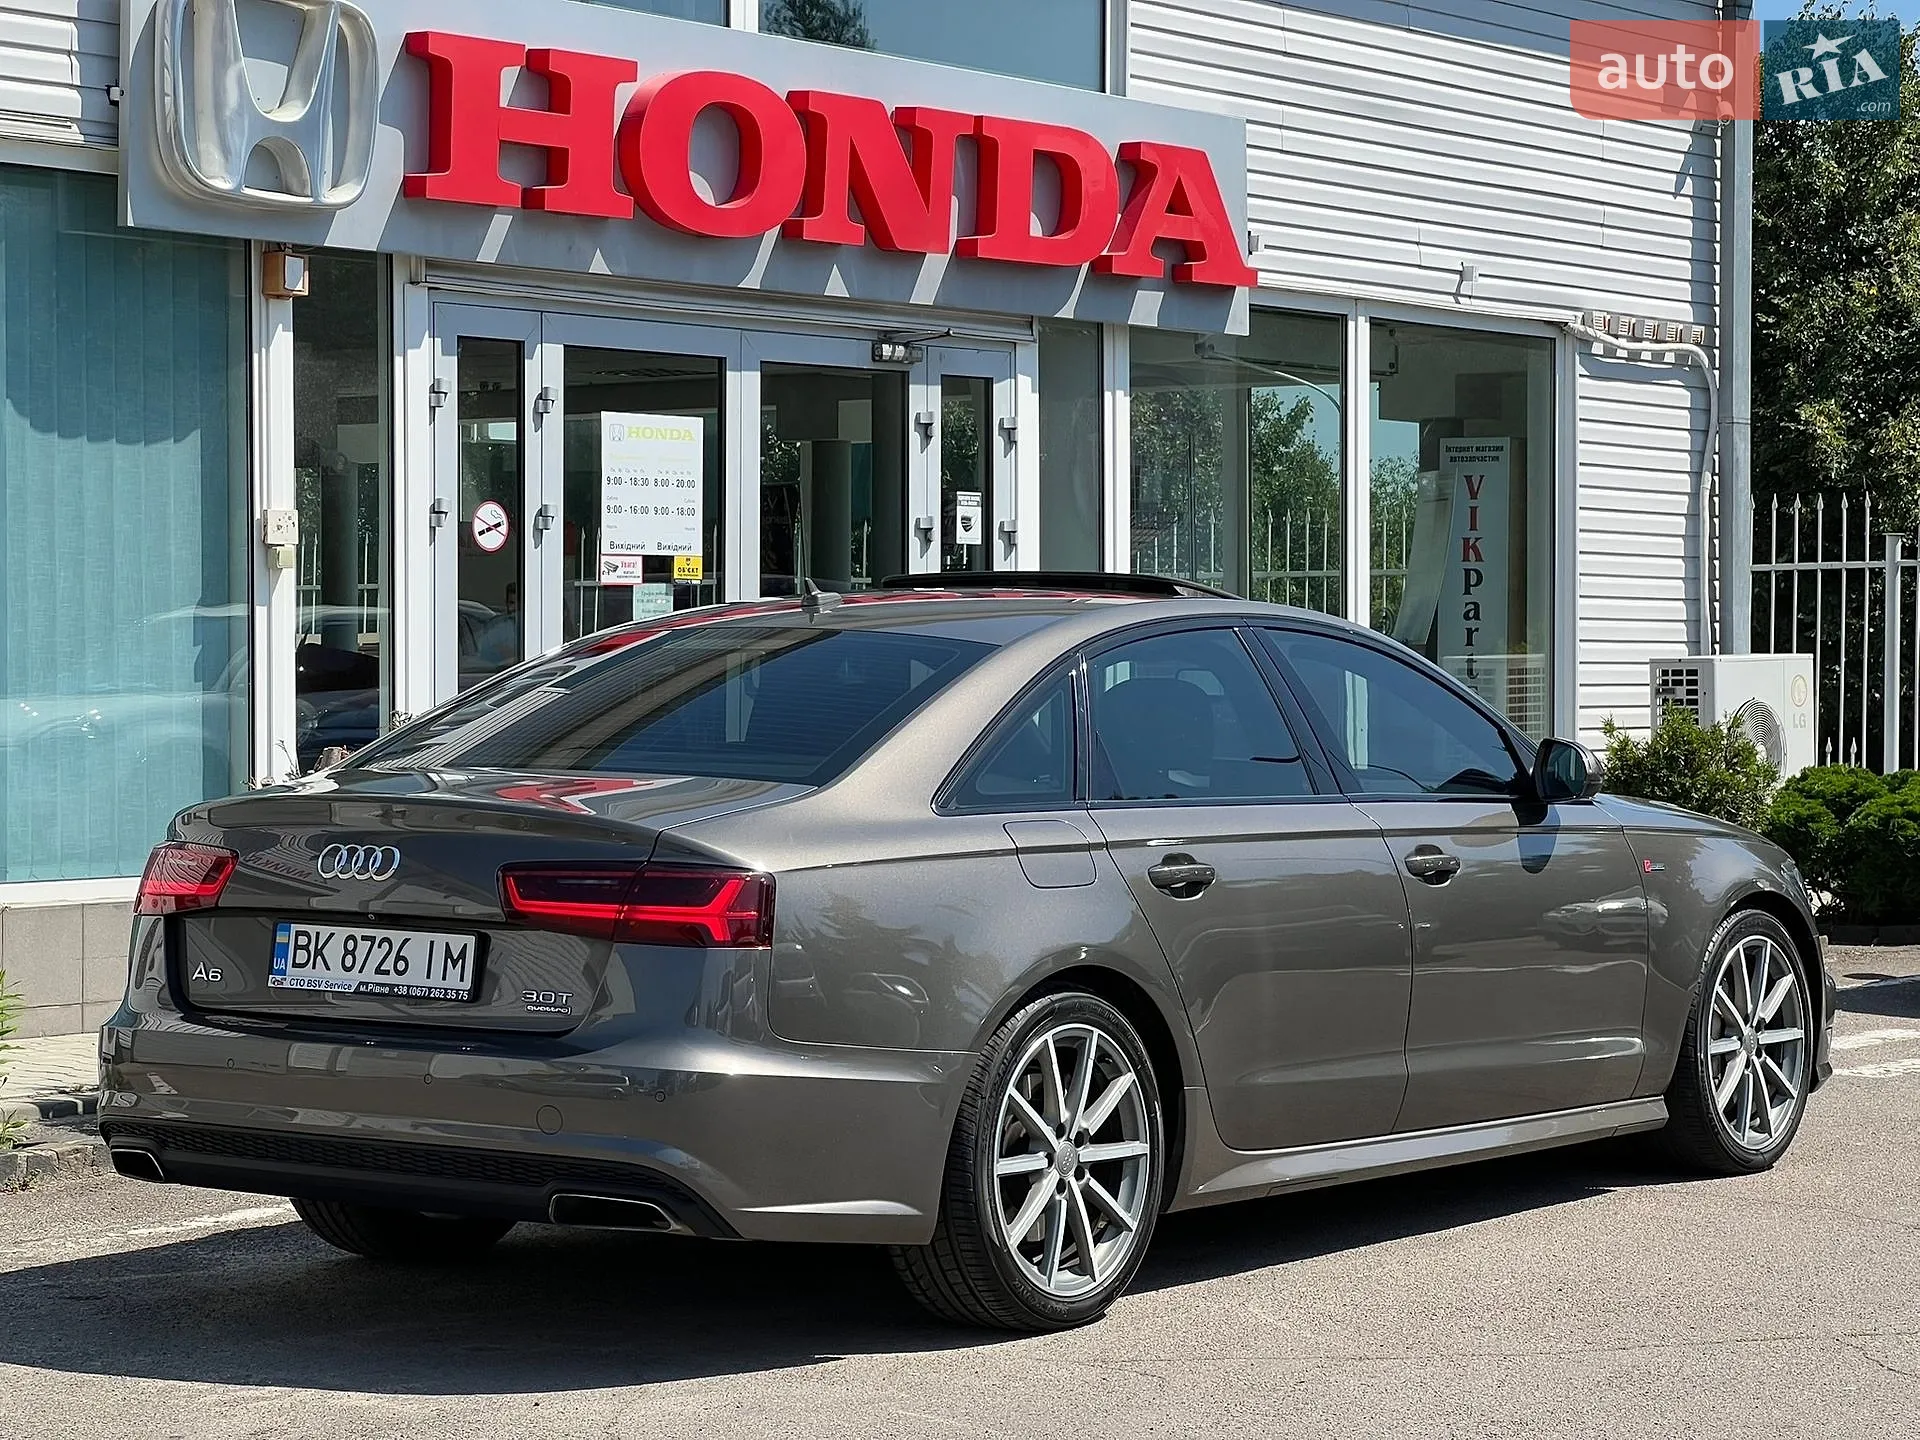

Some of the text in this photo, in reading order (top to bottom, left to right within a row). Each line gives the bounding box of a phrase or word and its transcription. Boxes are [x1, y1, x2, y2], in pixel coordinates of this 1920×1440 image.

[404, 30, 1258, 288] HONDA
[627, 426, 695, 442] HONDA
[1445, 445, 1504, 454] Інтернет магазин
[1449, 455, 1500, 463] автозапчастин
[606, 476, 622, 486] 9:00
[629, 477, 650, 487] 18:30
[653, 478, 669, 488] 8:00
[606, 504, 622, 514] 9:00
[629, 506, 650, 515] 16:00
[653, 506, 670, 515] 9:00
[676, 507, 696, 516] 18:00
[609, 541, 646, 551] Вихідний
[656, 542, 692, 552] Вихідний
[1792, 712, 1807, 728] LG
[291, 930, 468, 982] BK 8726 IM
[273, 957, 286, 970] UA
[192, 962, 222, 981] A6
[306, 979, 324, 989] BSV
[324, 981, 352, 991] Service
[393, 986, 407, 995] +38
[409, 987, 429, 997] (067)
[430, 989, 445, 999] 262
[446, 990, 457, 1000] 35
[458, 991, 469, 1001] 75
[526, 1005, 569, 1014] quattro
